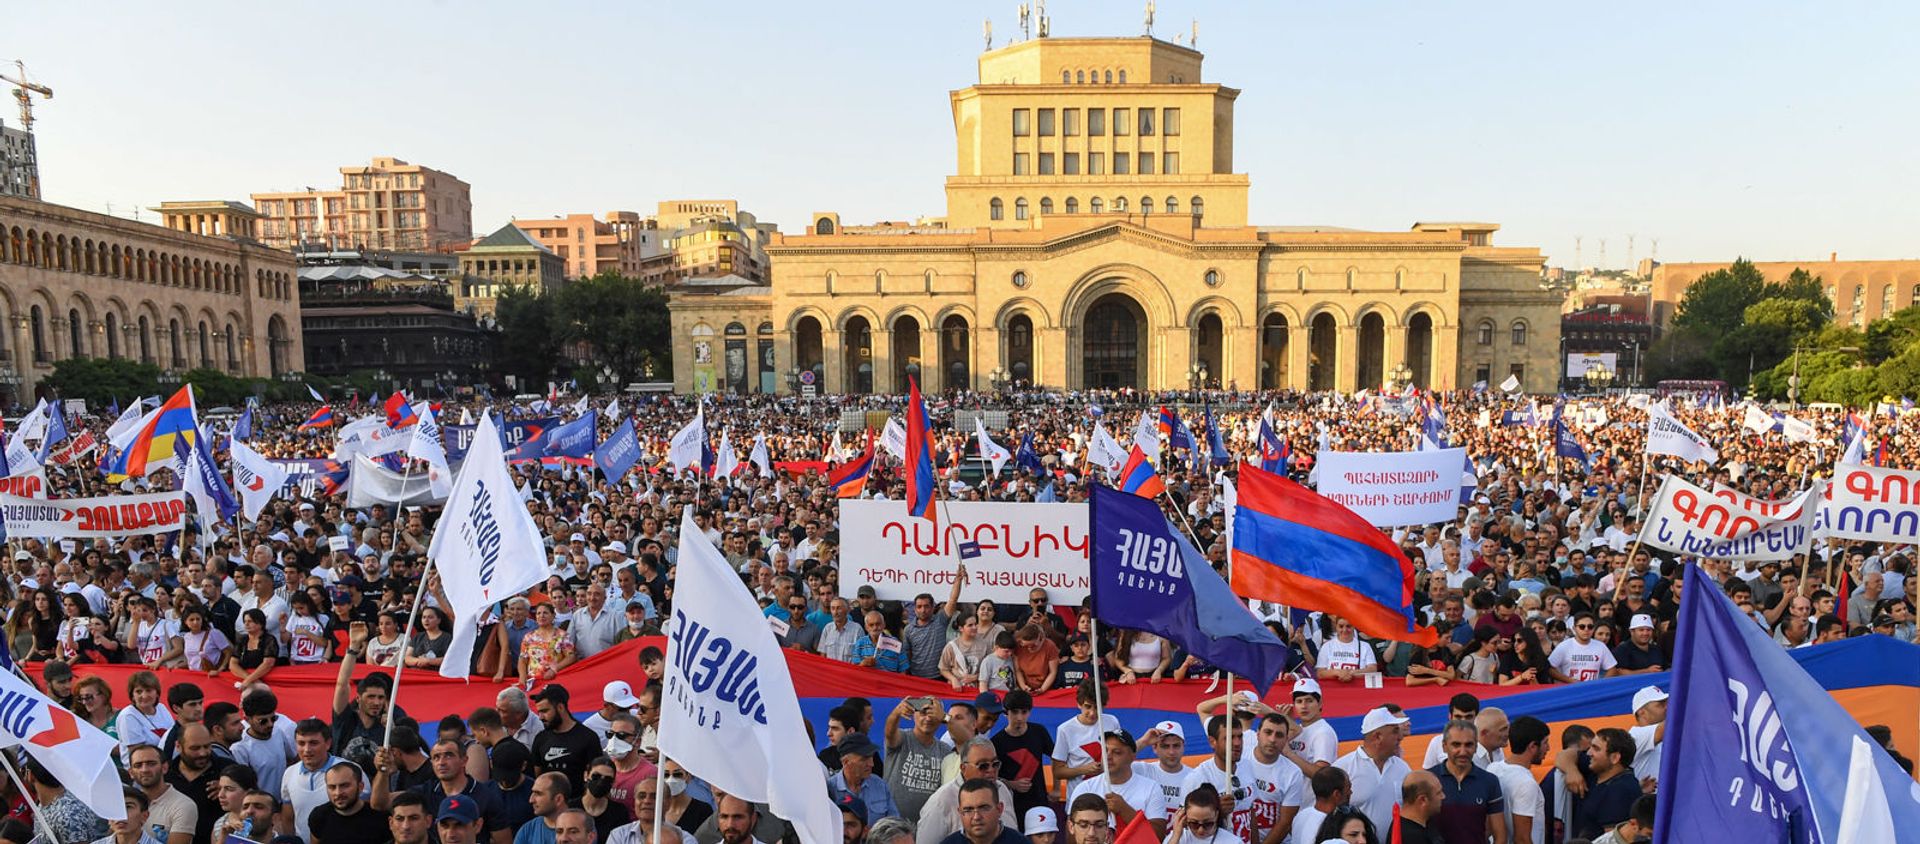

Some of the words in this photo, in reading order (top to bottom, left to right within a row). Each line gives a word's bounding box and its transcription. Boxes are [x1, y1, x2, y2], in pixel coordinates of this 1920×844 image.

[1343, 470, 1439, 485] ՊԱՀԵՍՏԱԶՈՐԻ
[1845, 470, 1920, 505] ԳՈ
[1393, 489, 1454, 506] ՇԱՐԺՈՒՄ
[1672, 489, 1770, 540] ԳՈՐ
[76, 498, 187, 532] ԶՈԼԱՔԱՐ
[1837, 506, 1919, 537] ՈՐՈ
[882, 521, 1089, 560] ԴԱՐԲՆԻԿ
[859, 568, 909, 584] ԴԵՊԻ
[976, 570, 1074, 589] ՀԱՅԱՍՏԱՆ
[0, 687, 39, 739] ԱՆ
